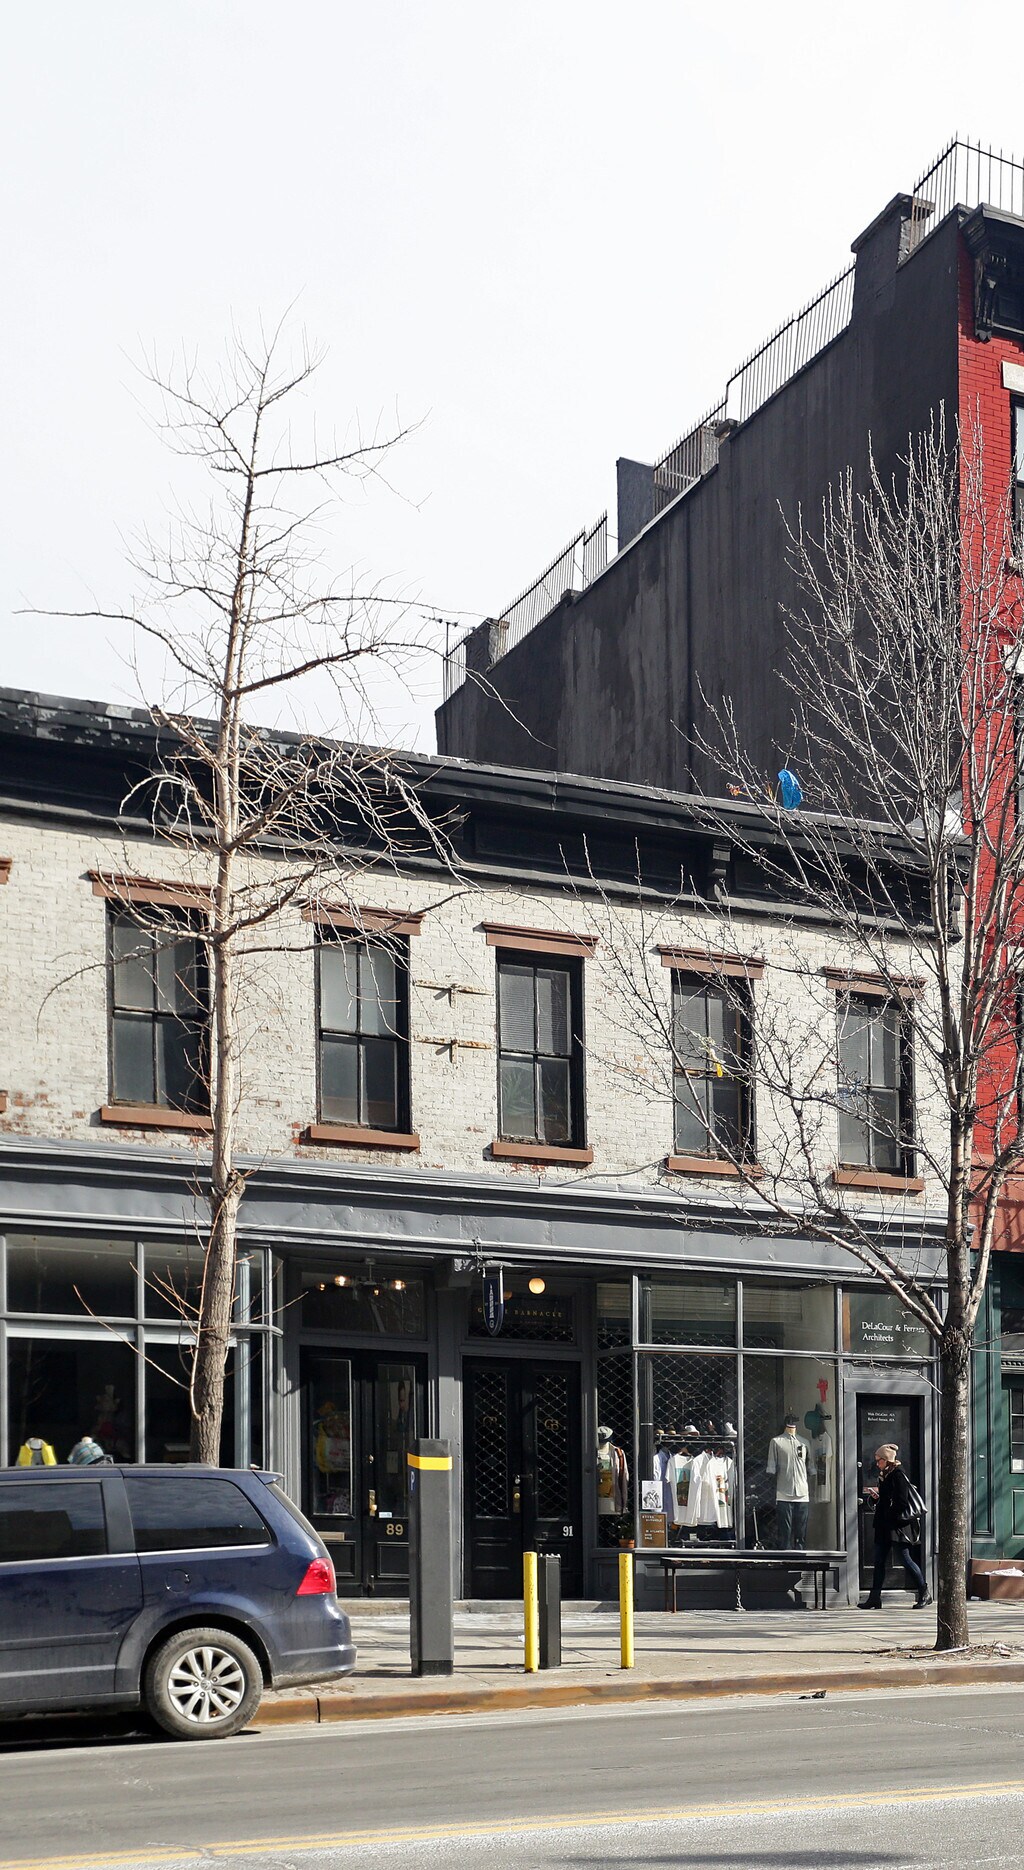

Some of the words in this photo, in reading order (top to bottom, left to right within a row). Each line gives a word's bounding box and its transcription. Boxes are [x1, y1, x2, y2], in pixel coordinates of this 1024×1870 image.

[861, 1321, 894, 1332] DeLaCour
[895, 1324, 902, 1332] &
[862, 1333, 895, 1342] Architects
[385, 1523, 404, 1536] 89
[562, 1525, 574, 1537] 91
